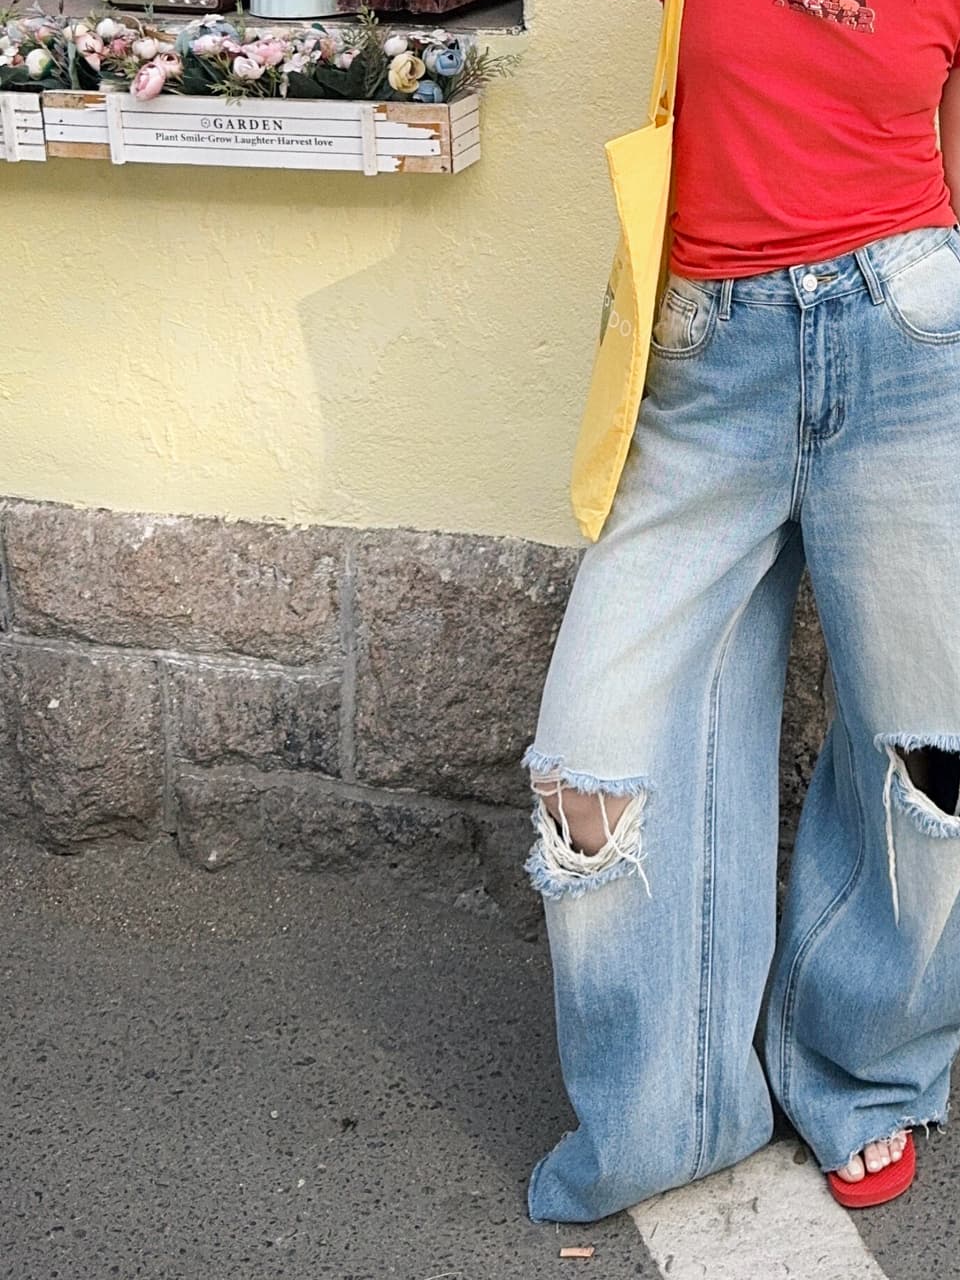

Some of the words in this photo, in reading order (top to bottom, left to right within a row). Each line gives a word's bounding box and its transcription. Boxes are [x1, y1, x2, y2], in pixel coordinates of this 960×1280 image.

[212, 117, 284, 131] GARDEN
[155, 132, 179, 142] Plant
[314, 137, 334, 147] love
